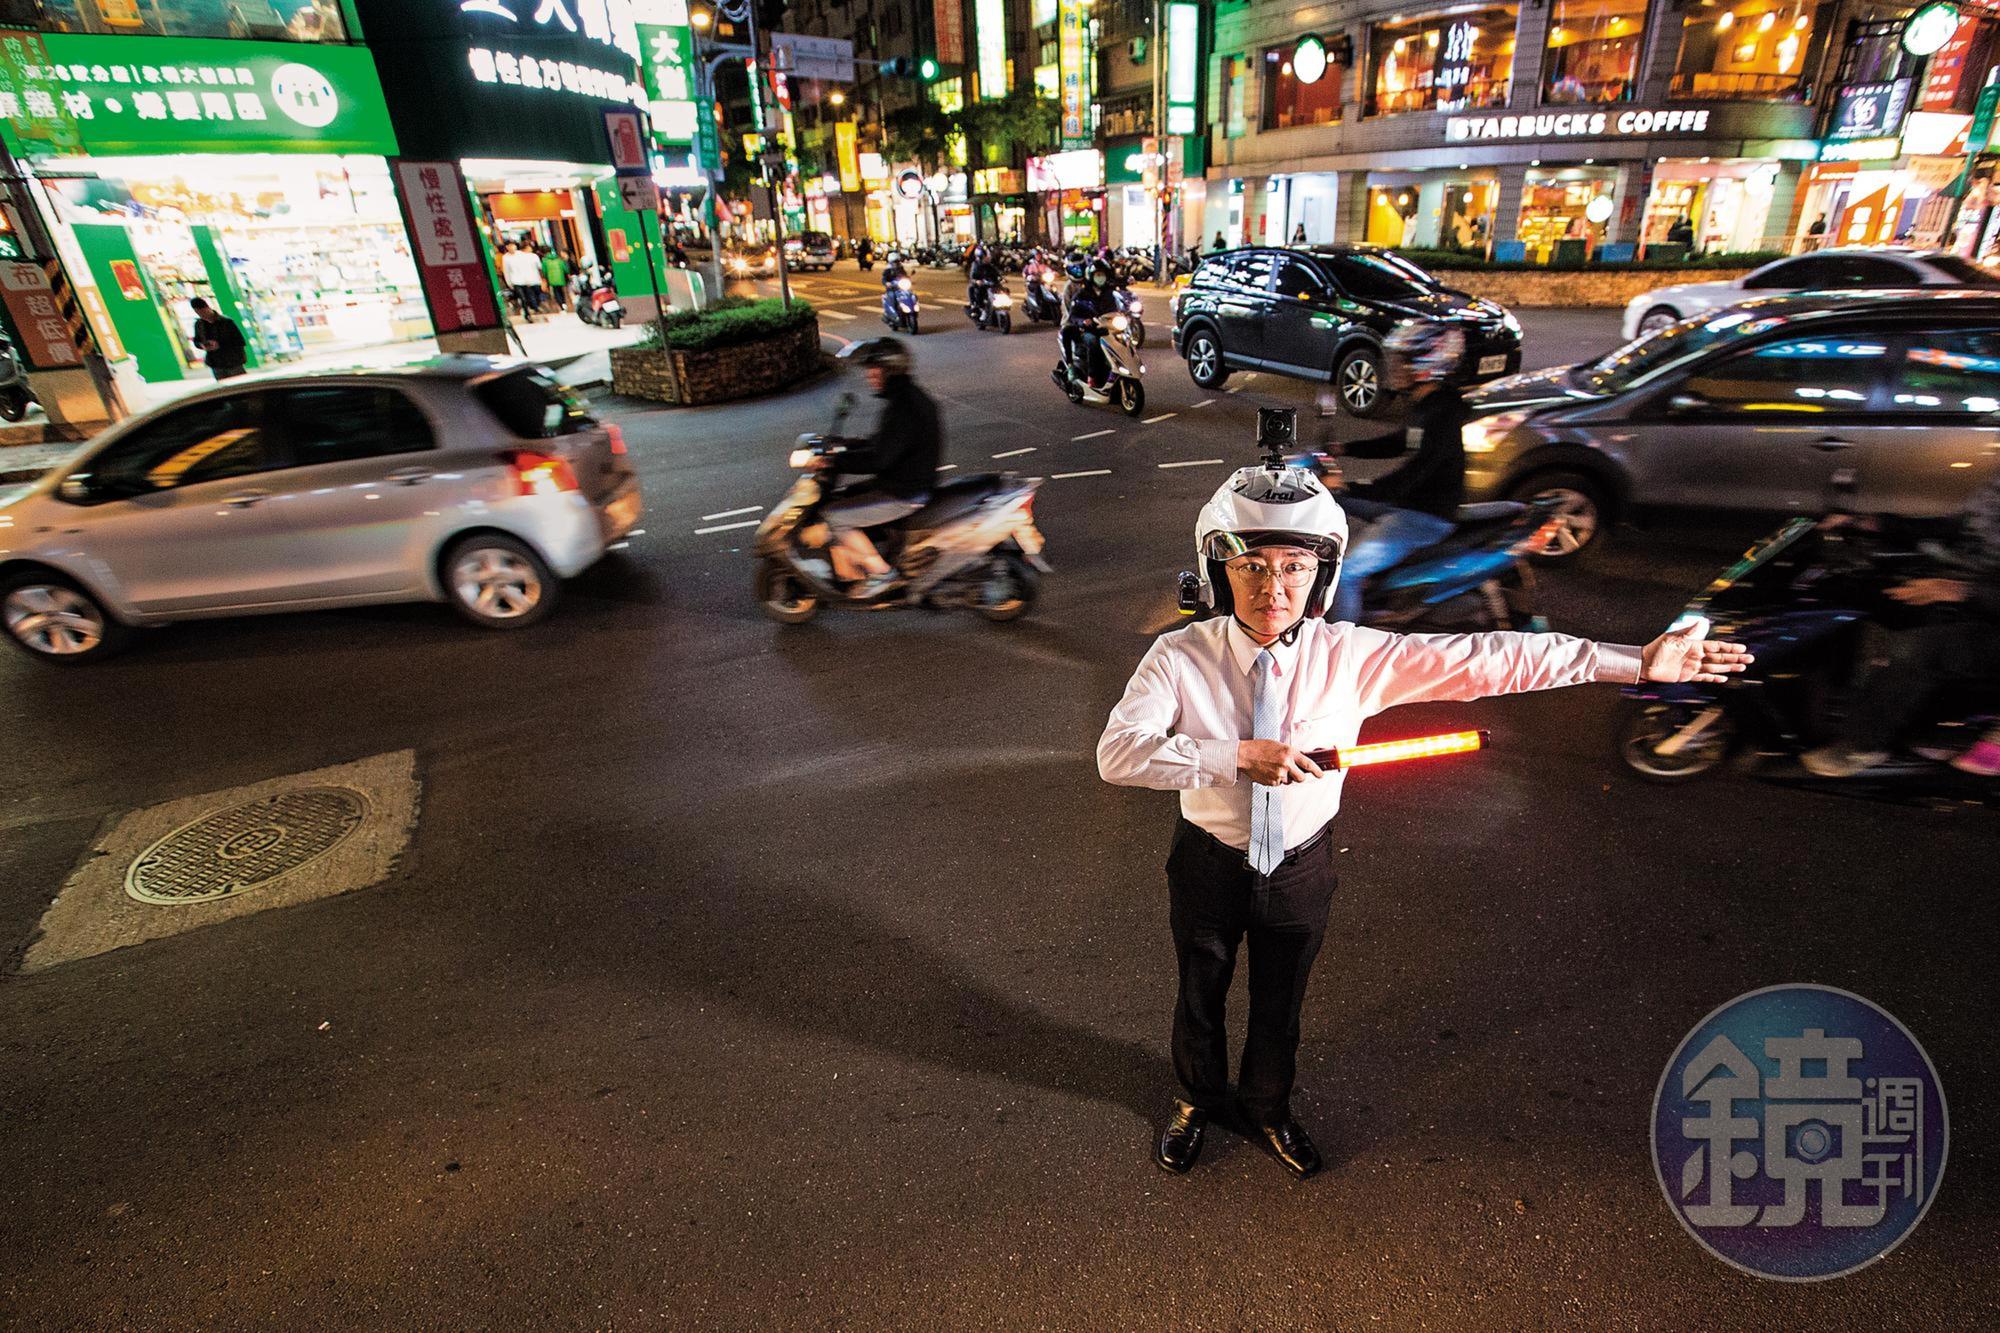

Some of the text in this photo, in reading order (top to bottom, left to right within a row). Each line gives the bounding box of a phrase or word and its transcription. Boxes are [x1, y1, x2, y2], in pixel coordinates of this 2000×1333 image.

[1453, 110, 1710, 140] STARBUCKS COFFEE
[419, 167, 458, 261] 慢性處方
